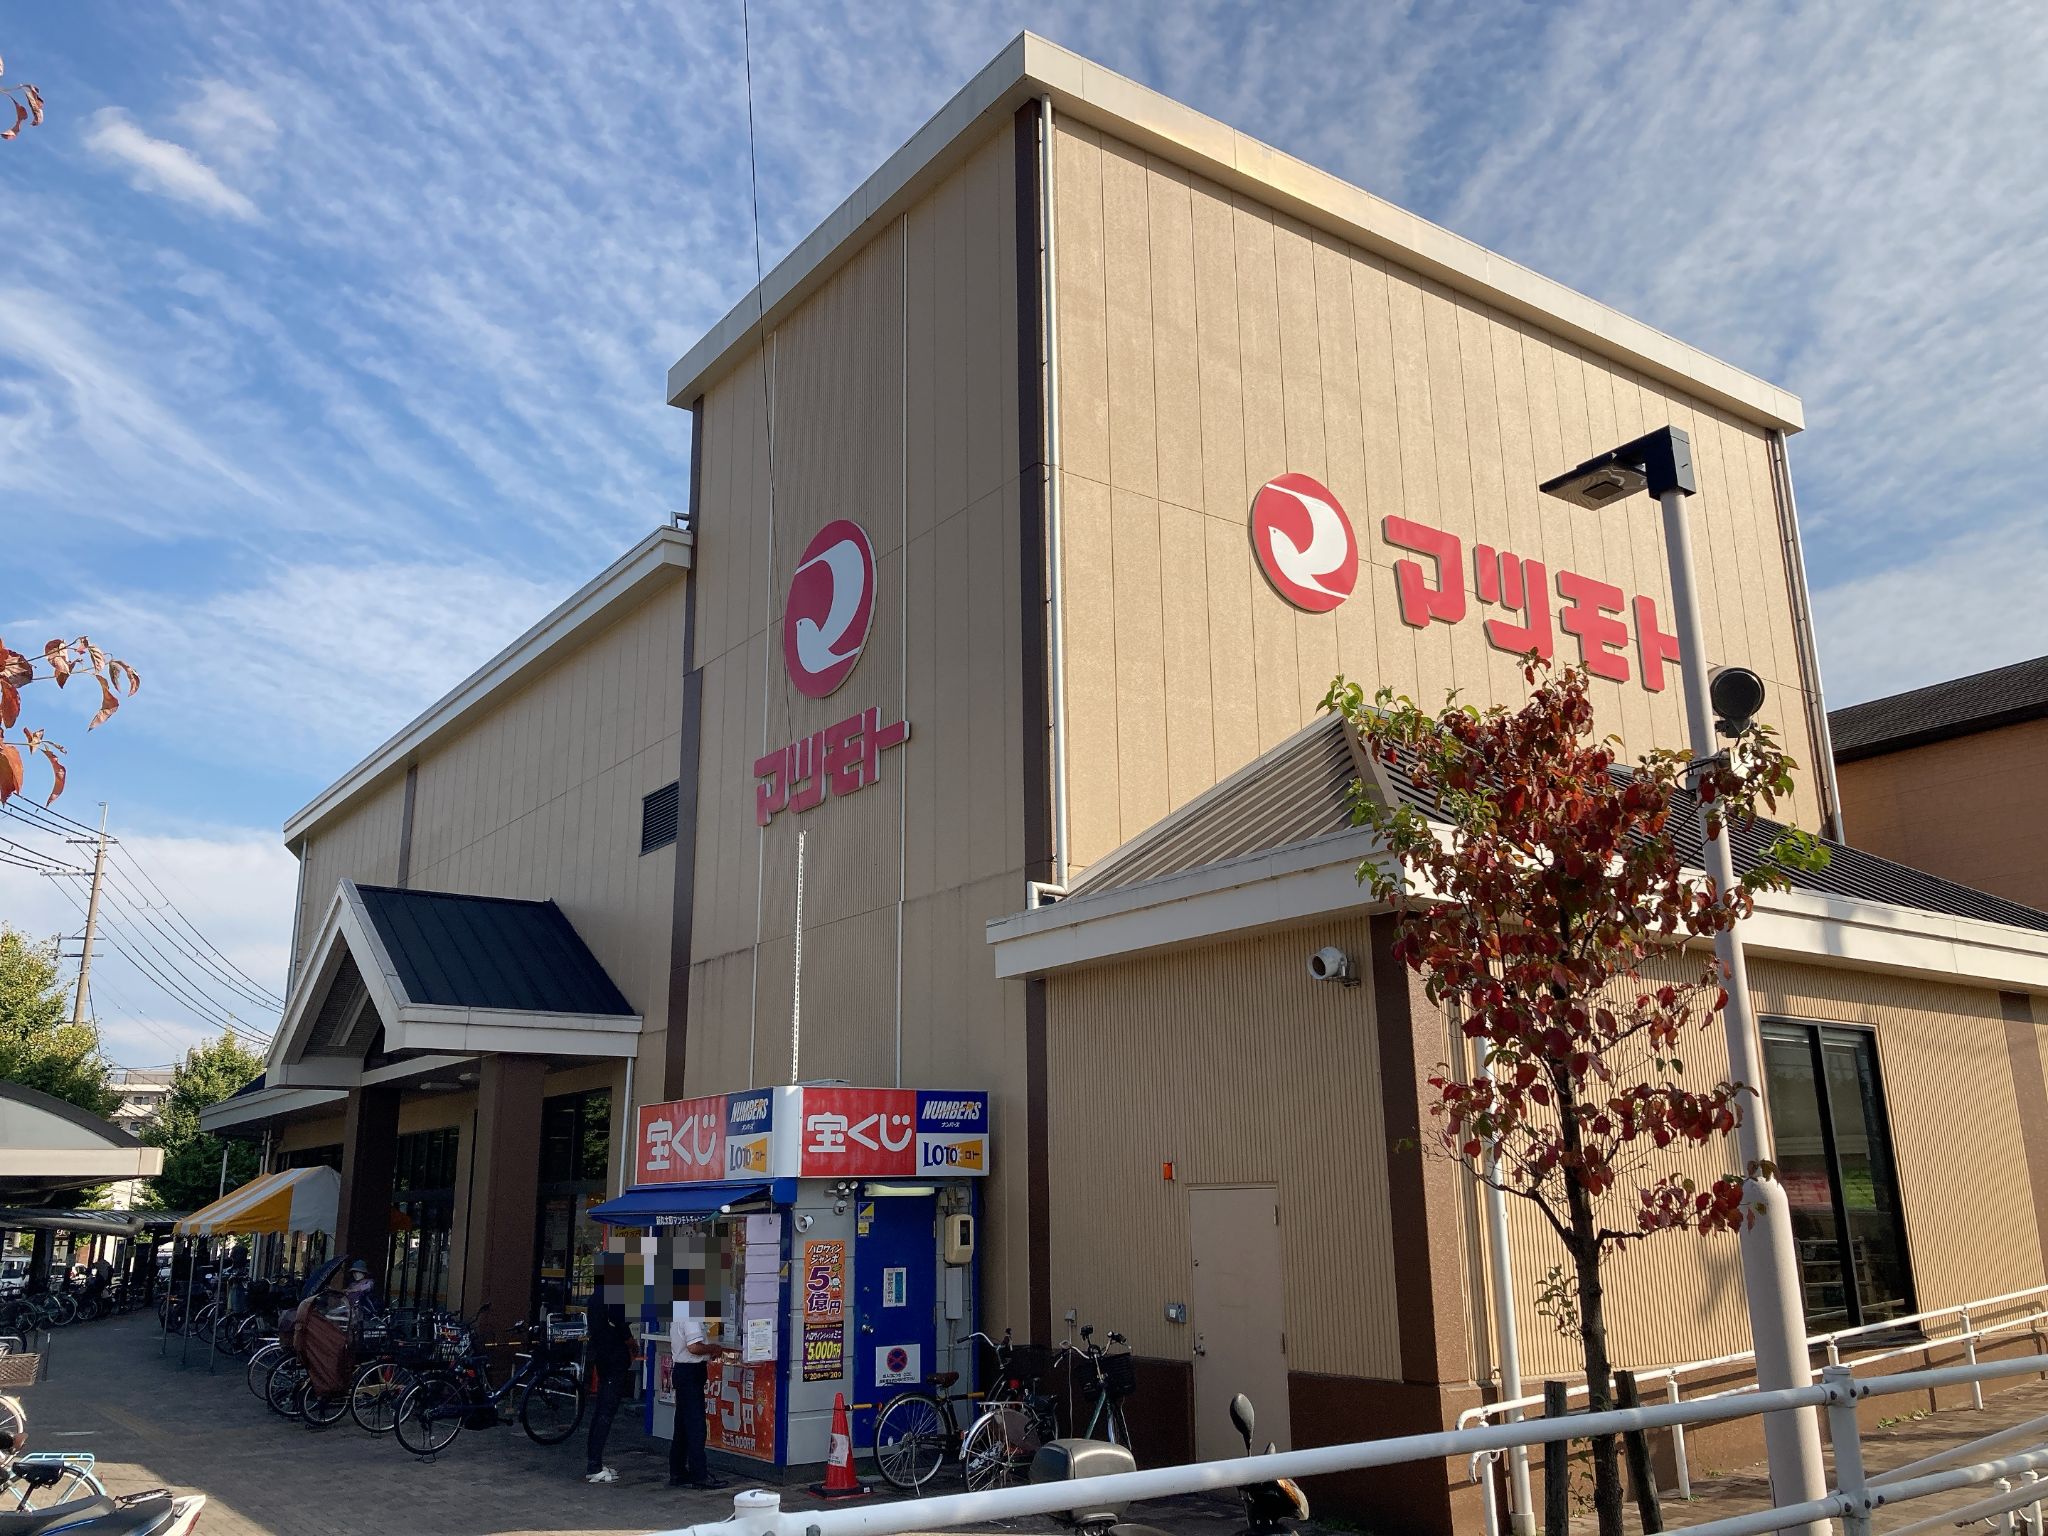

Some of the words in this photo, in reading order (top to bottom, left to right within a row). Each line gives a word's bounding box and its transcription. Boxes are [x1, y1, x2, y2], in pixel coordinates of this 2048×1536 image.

[1382, 515, 1681, 692] マツモト
[754, 706, 911, 827] マツモト
[730, 1098, 769, 1123] NUMBERS
[921, 1100, 982, 1120] NUMBERS
[646, 1113, 717, 1171] 宝くじ
[807, 1112, 912, 1153] 宝くじ
[730, 1144, 752, 1171] LOTO
[923, 1141, 959, 1168] LOTO
[964, 1150, 980, 1160] ロト
